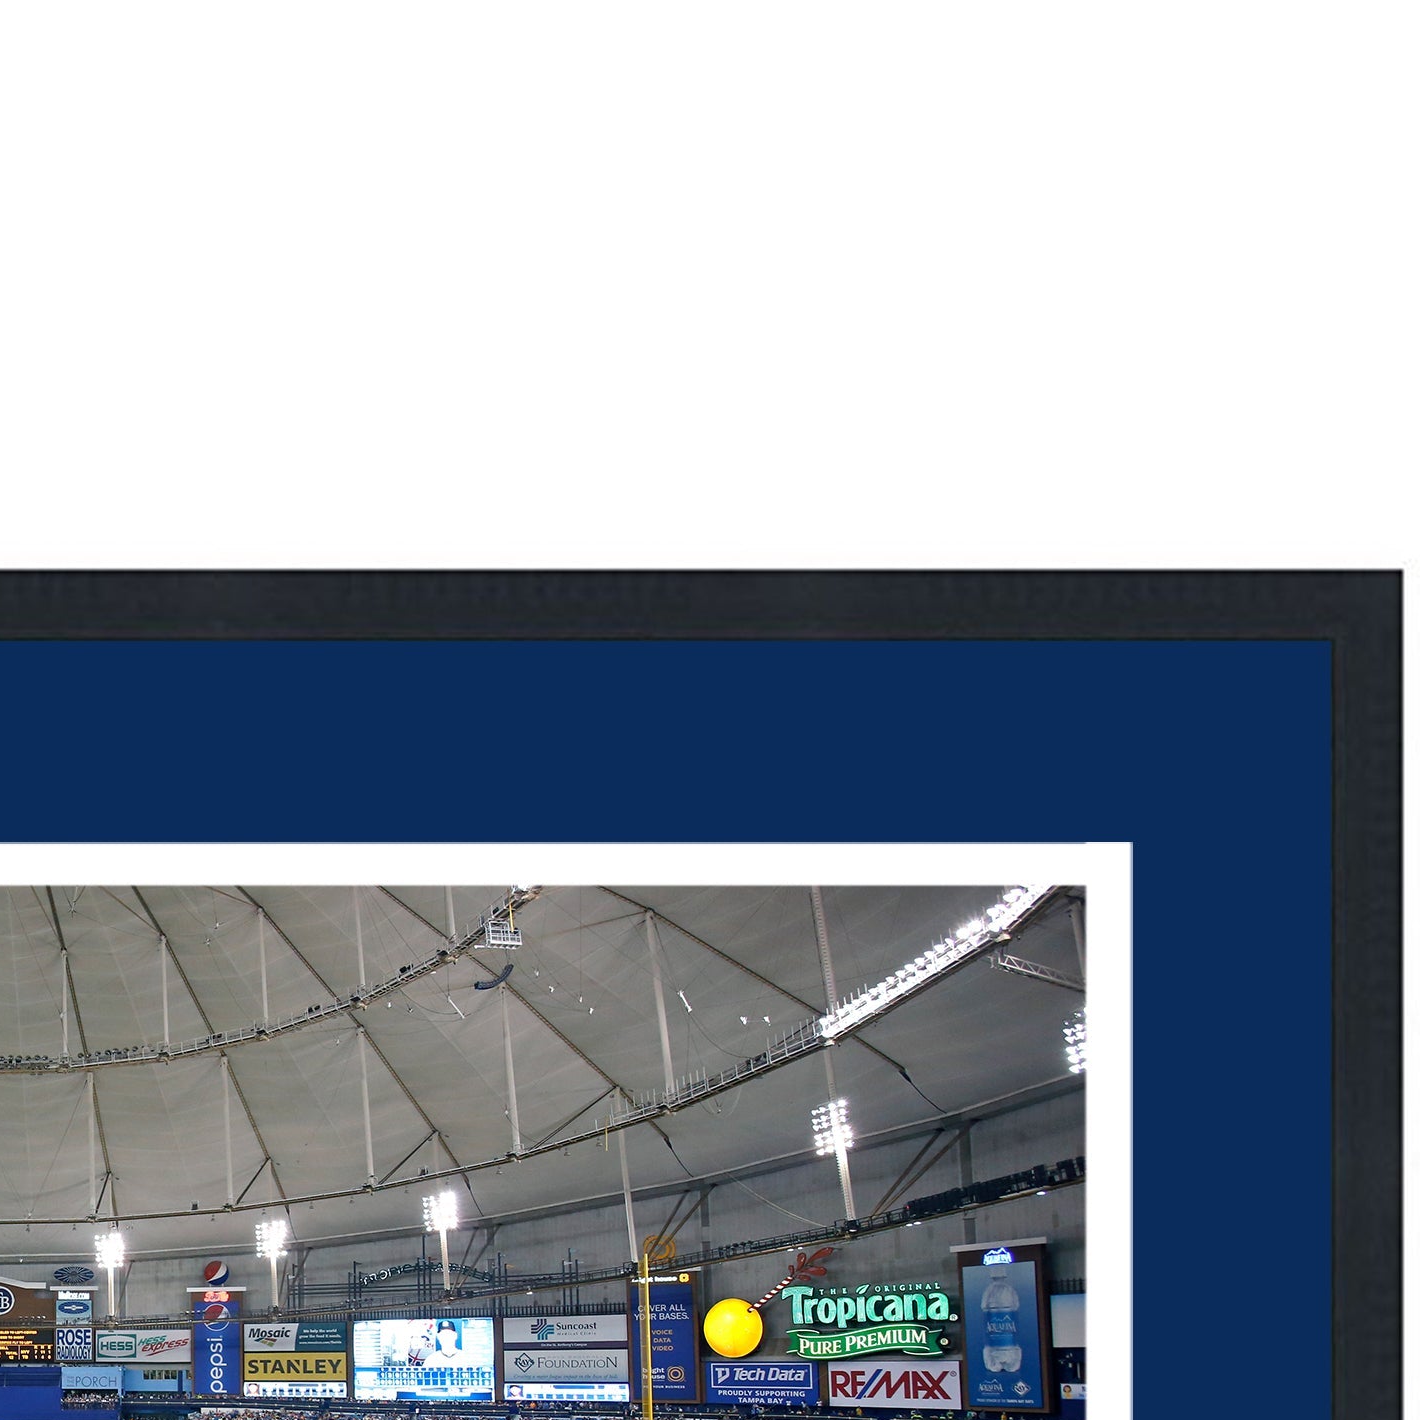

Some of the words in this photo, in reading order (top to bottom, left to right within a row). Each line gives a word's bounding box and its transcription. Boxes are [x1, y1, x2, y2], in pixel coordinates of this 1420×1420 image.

[819, 1287, 848, 1295] THE
[874, 1282, 941, 1293] ORIGINAL
[637, 1304, 667, 1312] CVER
[782, 1284, 951, 1328] Tropicana
[659, 1312, 689, 1320] BASES.
[248, 1327, 291, 1338] Mosaic
[556, 1322, 597, 1331] Suncoast
[56, 1329, 92, 1346] ROSE
[138, 1335, 167, 1346] HESS
[799, 1337, 842, 1355] PURE
[845, 1329, 927, 1350] PREMIUM
[100, 1341, 133, 1351] HESS
[56, 1346, 92, 1360] RADIOLOGY
[208, 1337, 227, 1394] pepsi
[248, 1359, 342, 1374] STANLEY
[537, 1356, 618, 1369] FOUNDATION
[732, 1367, 766, 1381] Tech
[766, 1367, 805, 1382] Data
[75, 1376, 117, 1388] PORCH
[830, 1368, 952, 1400] RE/MAX
[718, 1389, 753, 1397] PROUDLY
[755, 1389, 806, 1397] SUPPORTING
